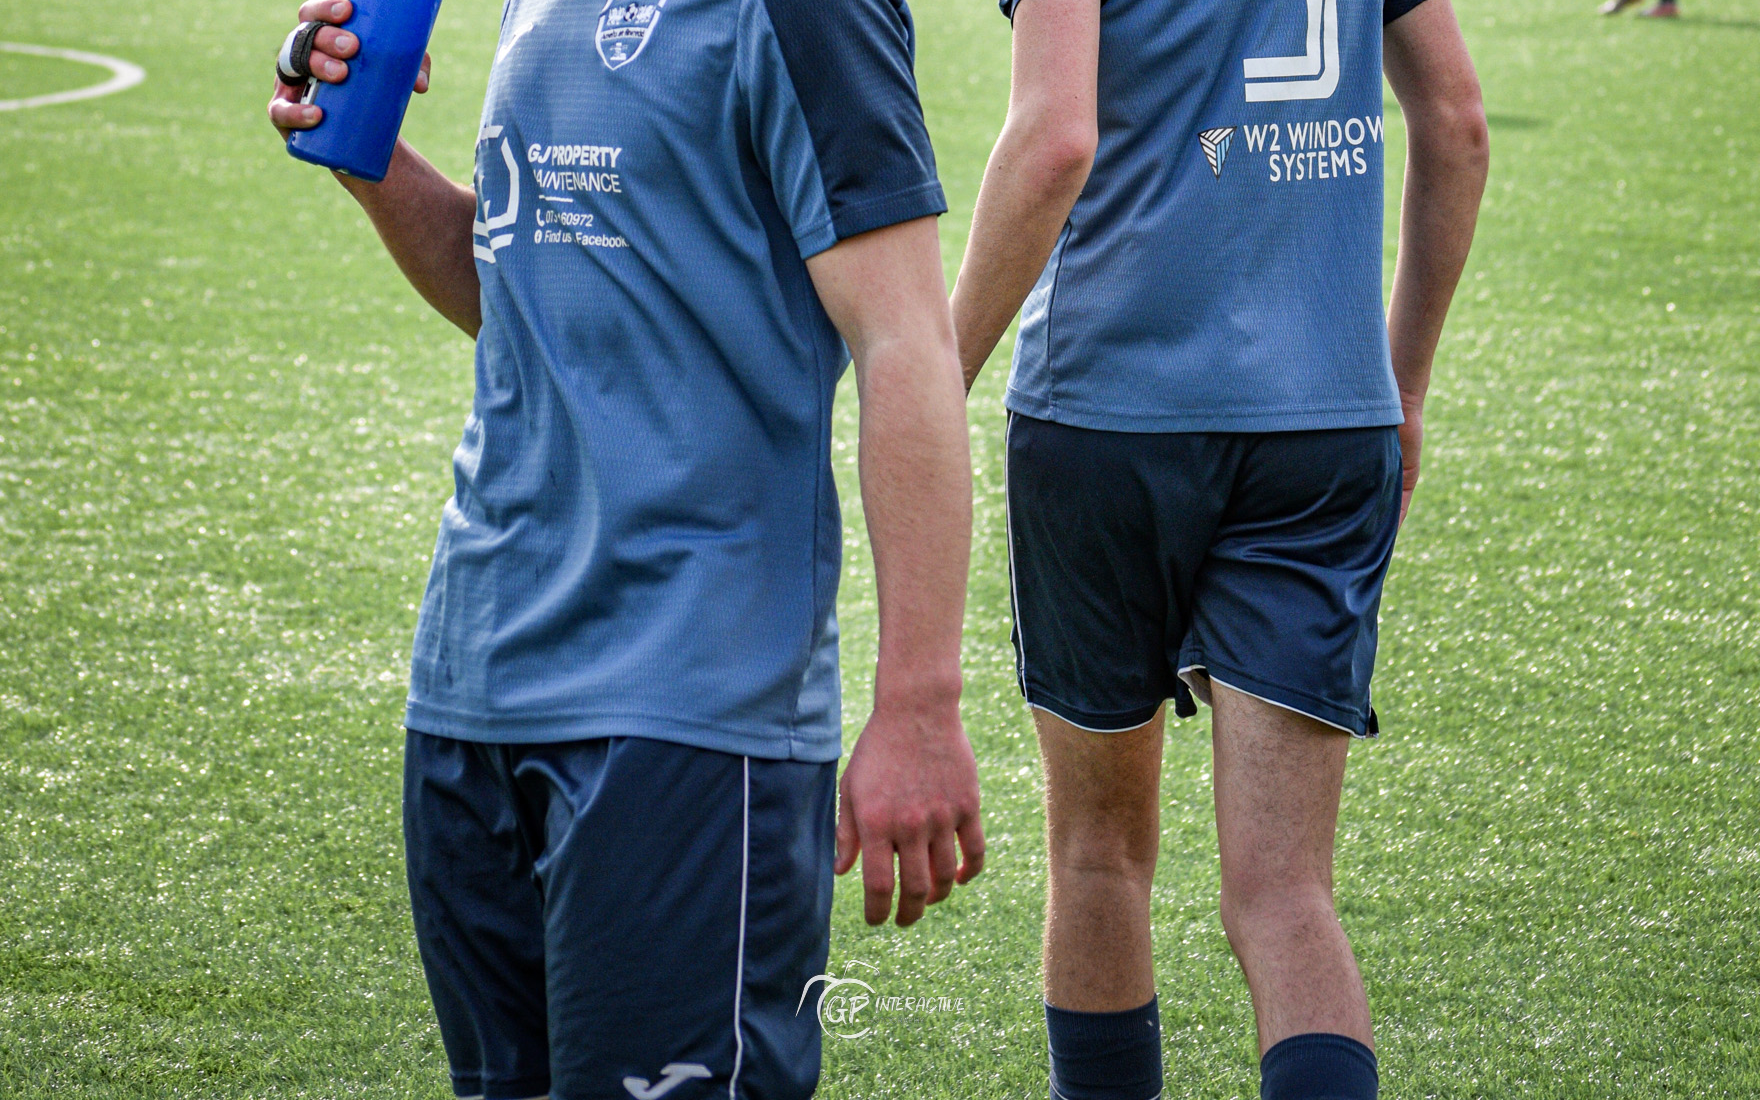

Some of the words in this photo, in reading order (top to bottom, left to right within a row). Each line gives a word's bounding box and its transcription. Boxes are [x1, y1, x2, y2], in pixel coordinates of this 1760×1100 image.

[1243, 123, 1281, 153] W2
[527, 143, 552, 164] GJ
[551, 144, 622, 168] PROPERTY
[1269, 147, 1367, 182] SYSTEMS
[534, 169, 622, 193] AINTENANCE
